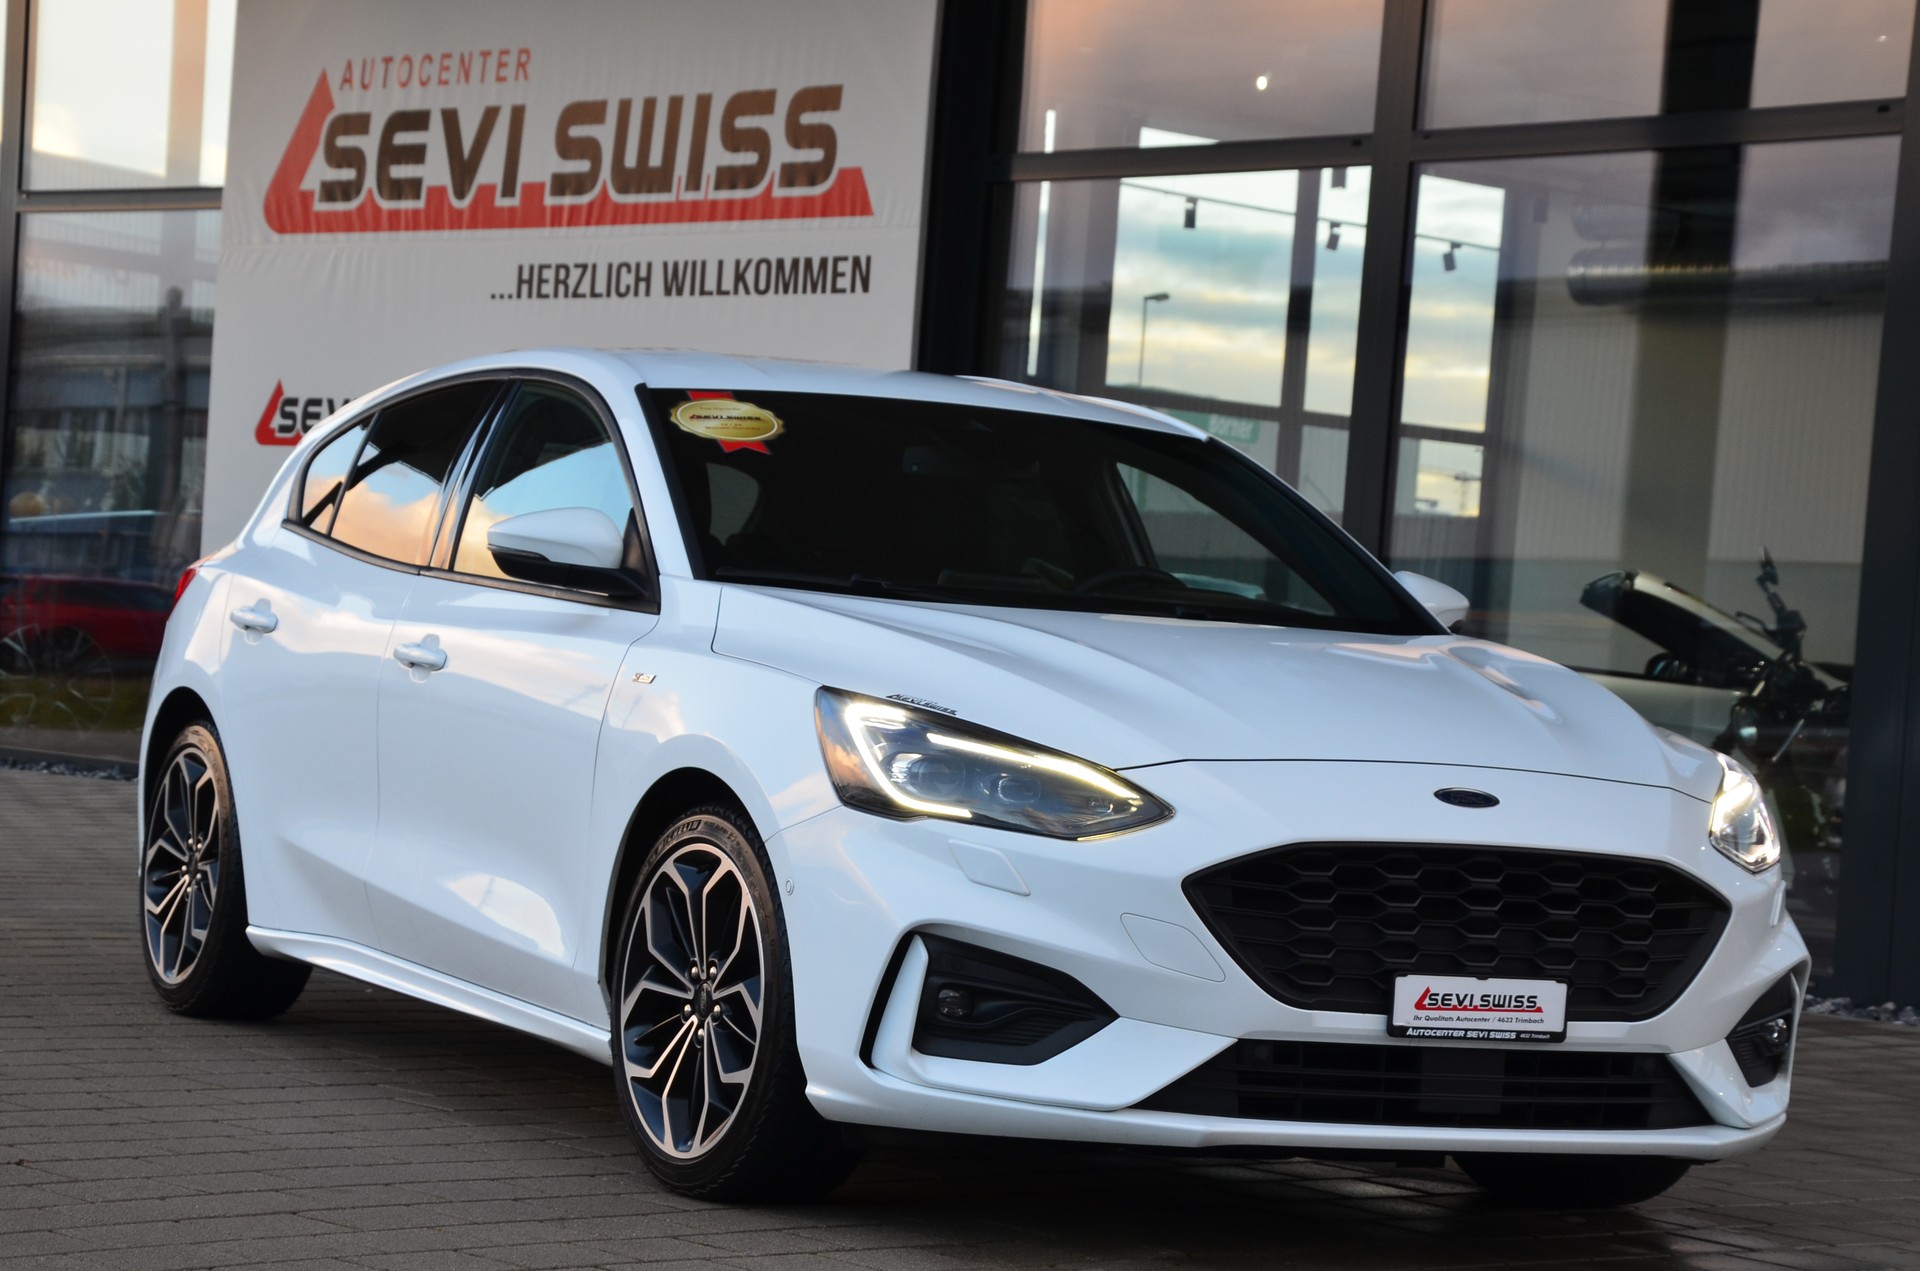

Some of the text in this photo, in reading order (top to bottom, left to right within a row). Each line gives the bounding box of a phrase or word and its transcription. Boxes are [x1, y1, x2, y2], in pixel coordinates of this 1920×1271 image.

[339, 48, 531, 91] AUTOCENTER
[318, 84, 843, 202] SEVI SWISS
[662, 255, 872, 298] WILLKOMMEN
[1427, 993, 1538, 1009] SEVI SWISS
[1406, 1027, 1465, 1037] AUTOCENTER
